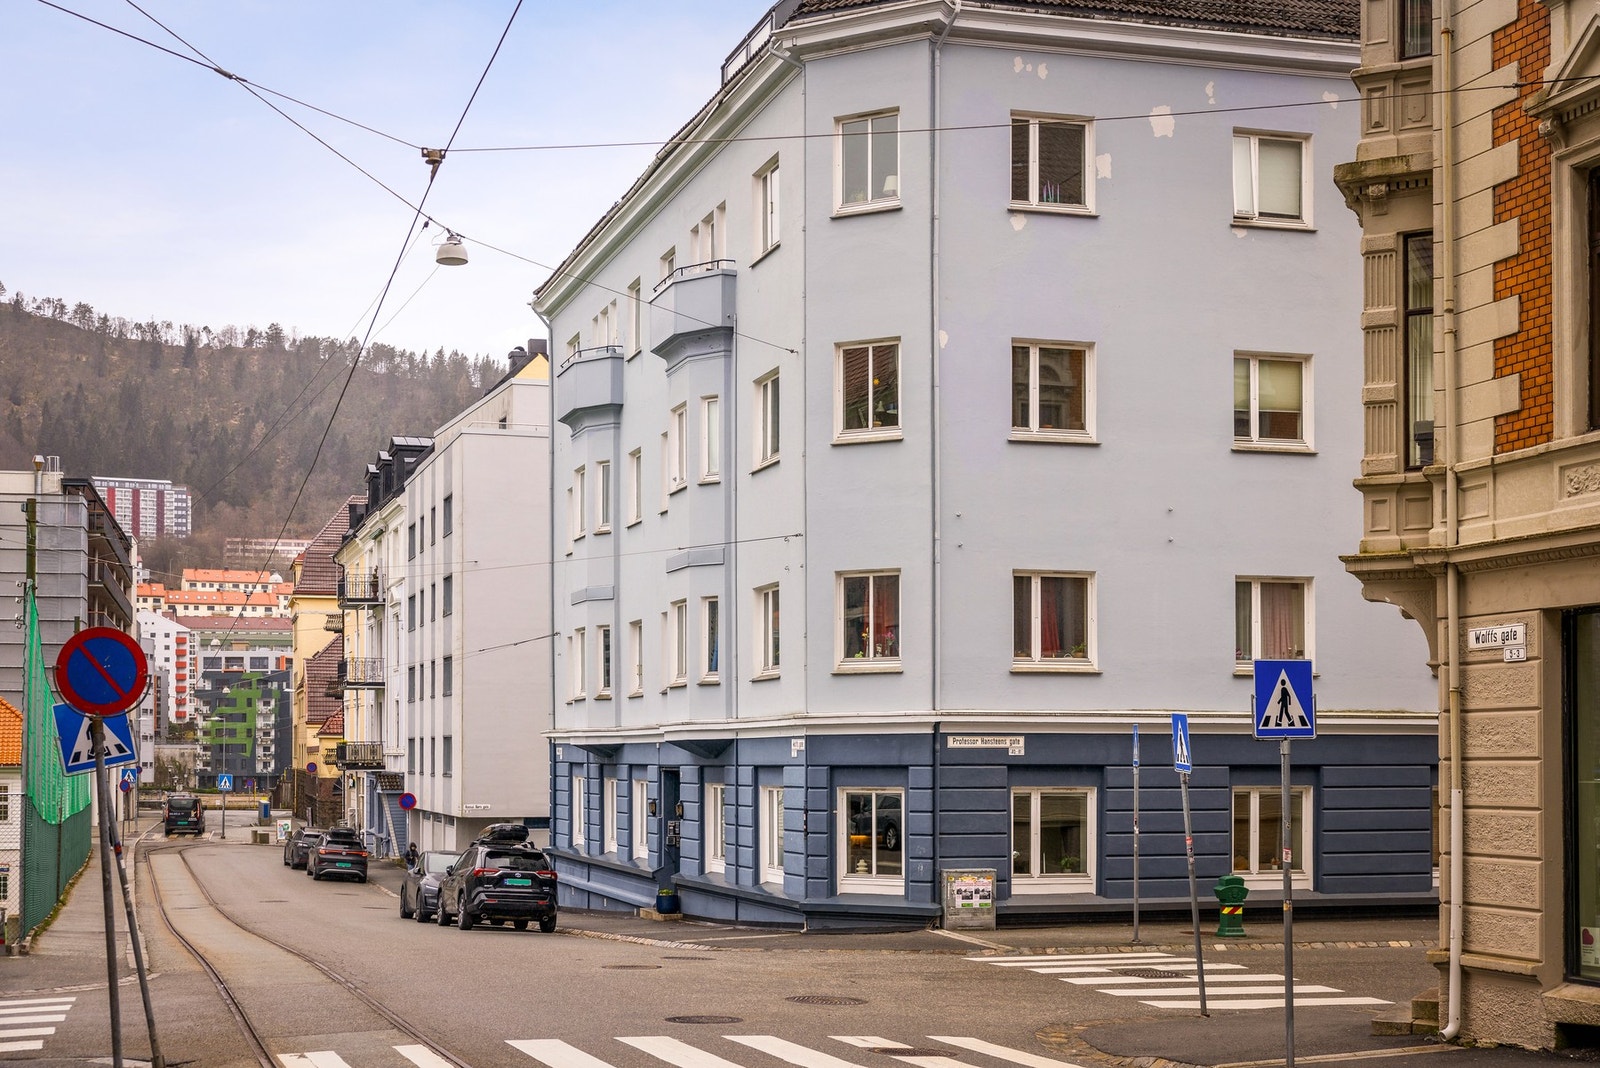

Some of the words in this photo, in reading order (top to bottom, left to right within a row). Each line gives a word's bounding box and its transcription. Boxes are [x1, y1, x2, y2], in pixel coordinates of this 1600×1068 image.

[1474, 630, 1498, 644] Wolffs
[1500, 628, 1518, 644] gate
[1009, 737, 1020, 746] gate
